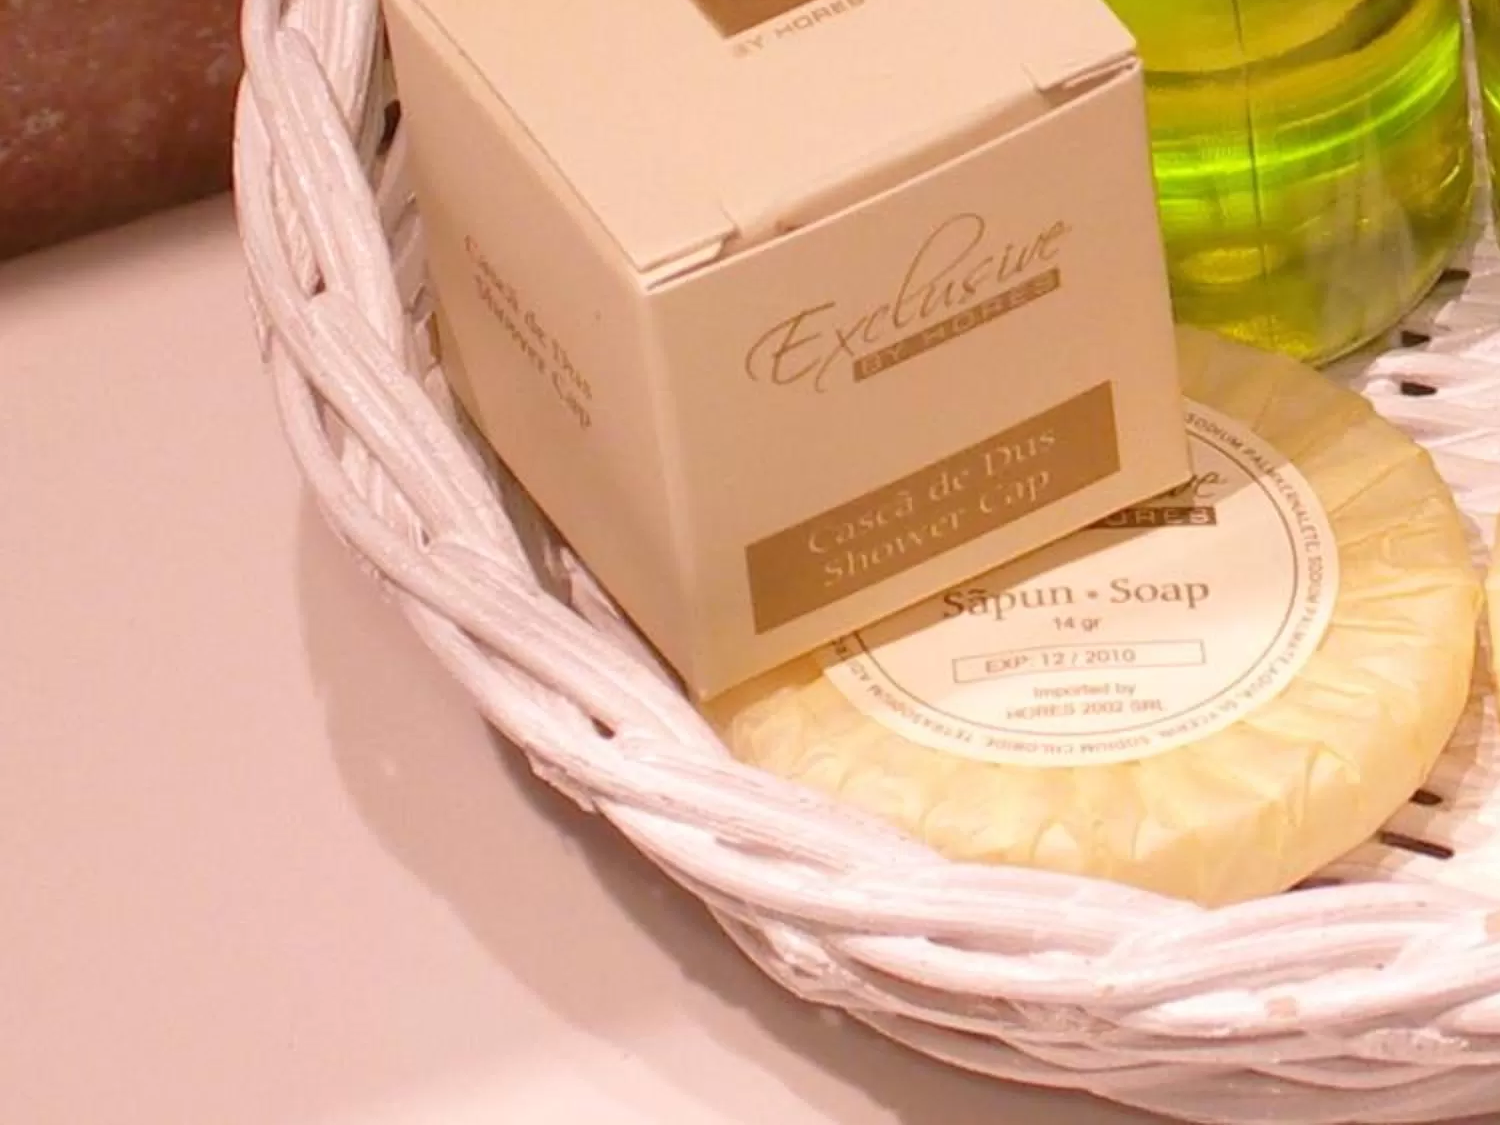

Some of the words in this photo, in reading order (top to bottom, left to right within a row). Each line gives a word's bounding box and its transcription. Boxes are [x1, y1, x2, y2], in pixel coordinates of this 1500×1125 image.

[731, 34, 765, 59] BY
[744, 212, 1072, 393] Exclusive
[863, 342, 900, 375] BY
[922, 271, 1053, 343] HORES
[928, 469, 970, 502] de
[983, 429, 1057, 477] Dus
[823, 507, 966, 588] Shower
[978, 469, 1051, 515] Cap
[1103, 507, 1210, 527] ORES
[1109, 576, 1211, 610] Soap
[1053, 615, 1076, 631] 14
[1080, 615, 1103, 633] gr
[1041, 651, 1065, 668] 12
[1085, 647, 1138, 665] 2010
[1115, 681, 1138, 698] by
[1006, 701, 1076, 722] HORES
[1082, 698, 1125, 717] 2002
